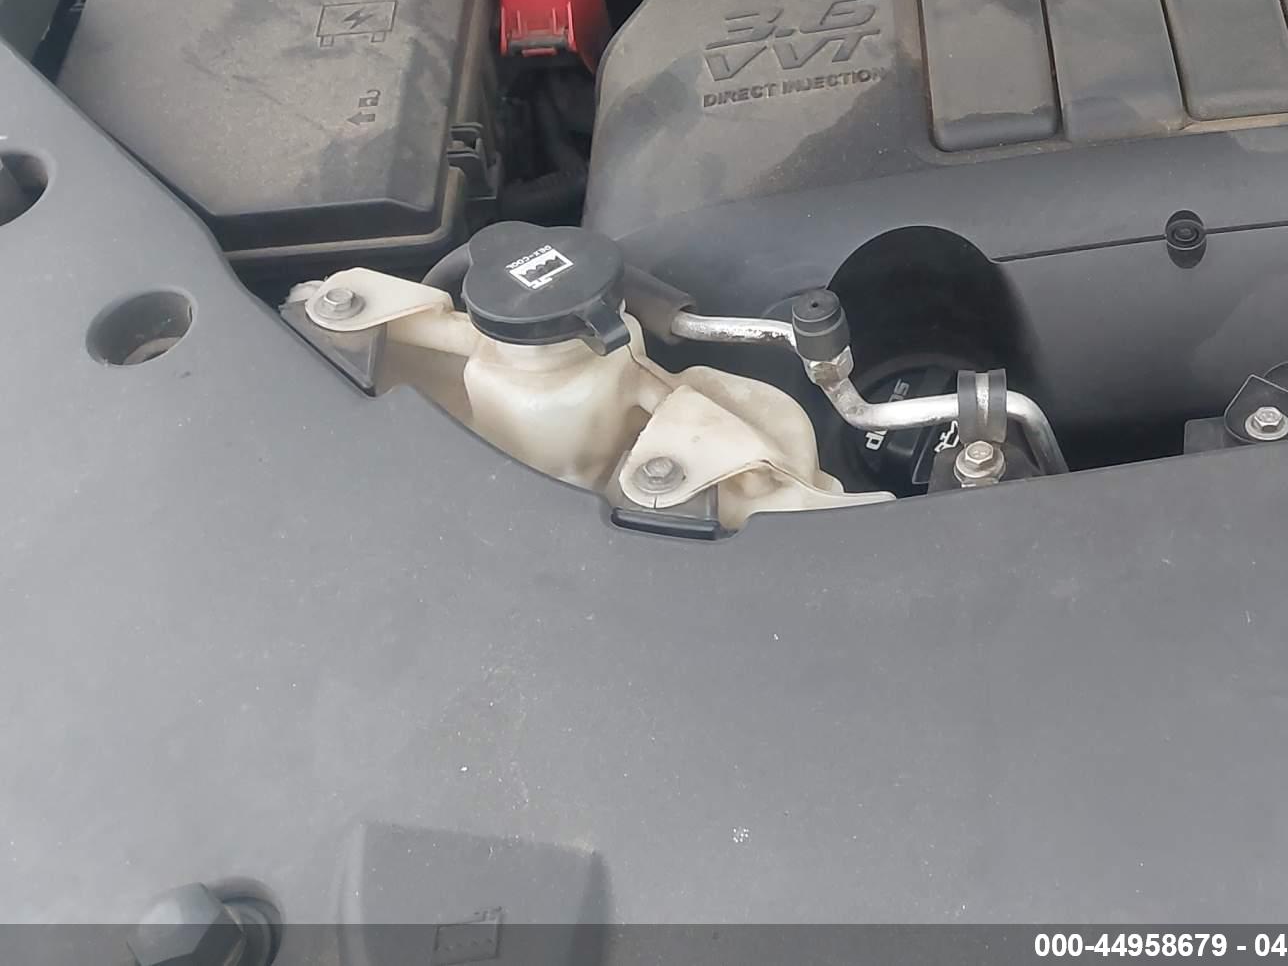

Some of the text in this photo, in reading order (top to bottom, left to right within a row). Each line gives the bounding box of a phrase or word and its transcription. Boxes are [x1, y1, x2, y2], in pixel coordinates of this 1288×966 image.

[704, 28, 881, 82] VVT
[703, 67, 886, 108] DIRECT INJECTION
